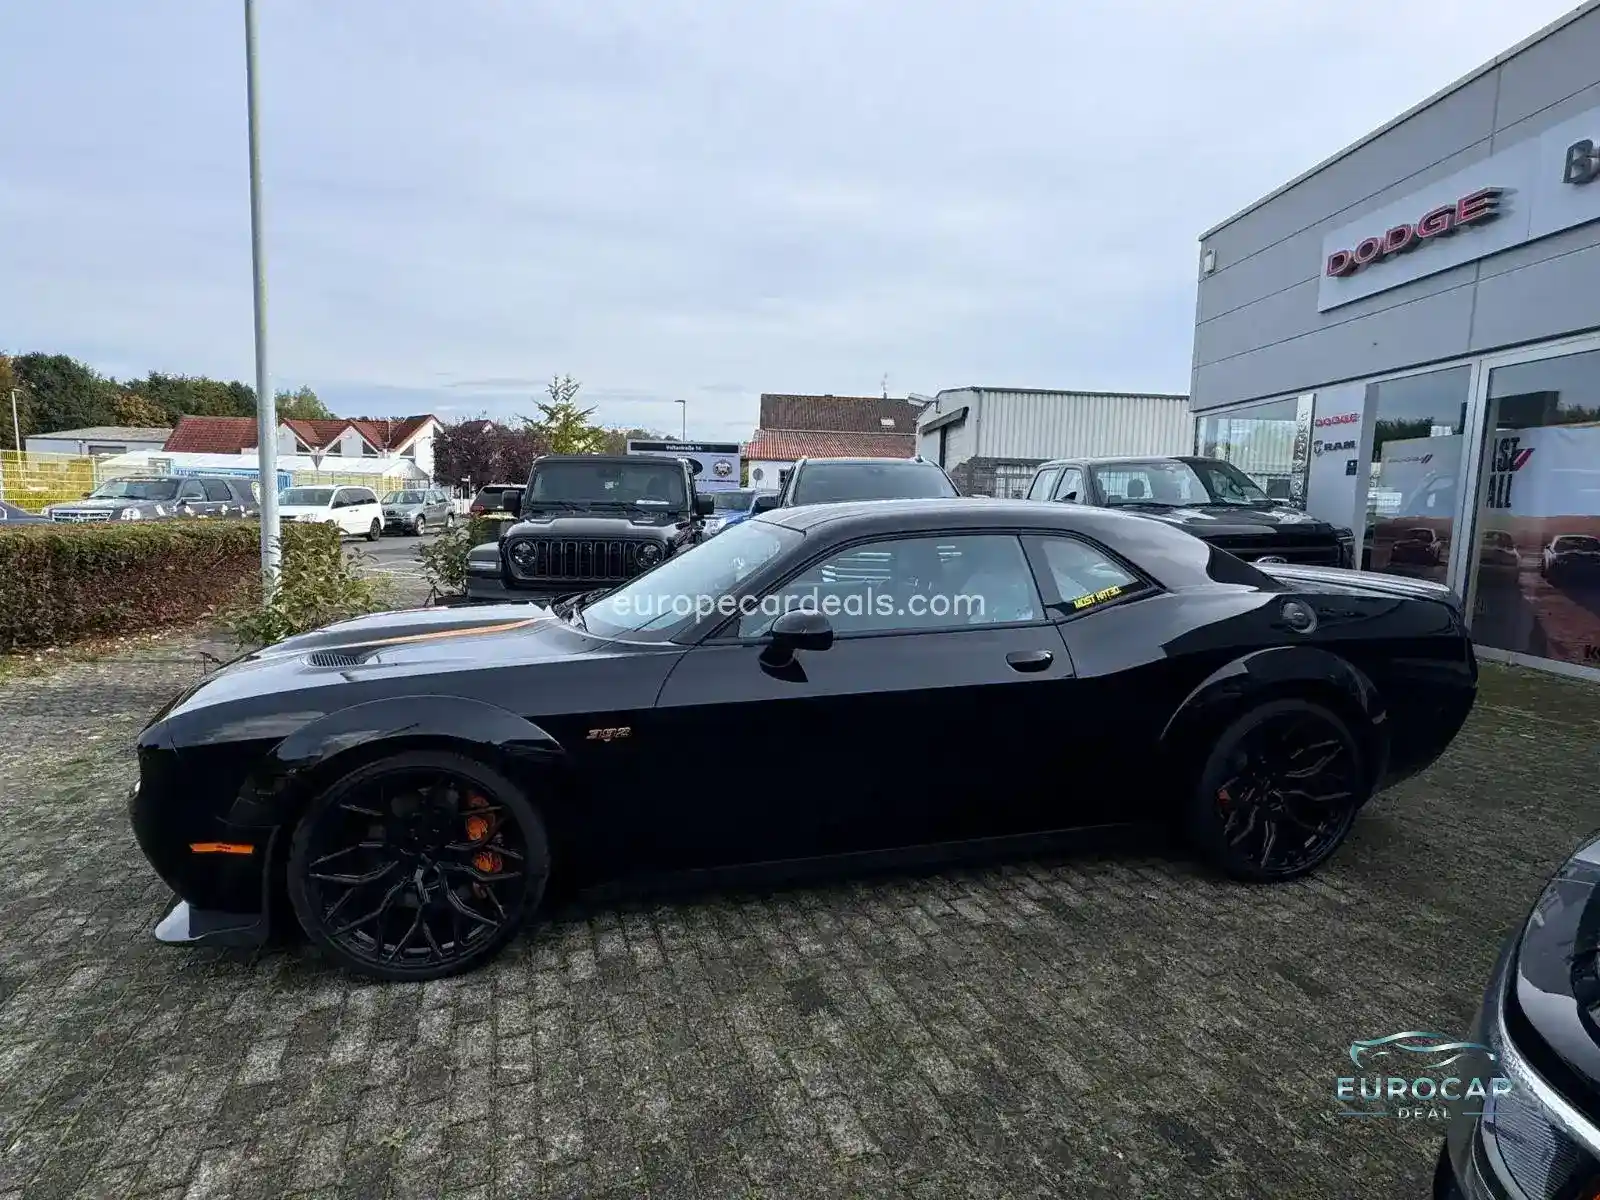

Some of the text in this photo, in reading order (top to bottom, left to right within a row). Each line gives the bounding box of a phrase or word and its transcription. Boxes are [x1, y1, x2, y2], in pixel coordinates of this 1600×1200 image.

[1326, 186, 1504, 278] DODGE
[1315, 413, 1359, 427] DODGE
[1323, 440, 1355, 451] RAM
[1073, 594, 1097, 609] MOST
